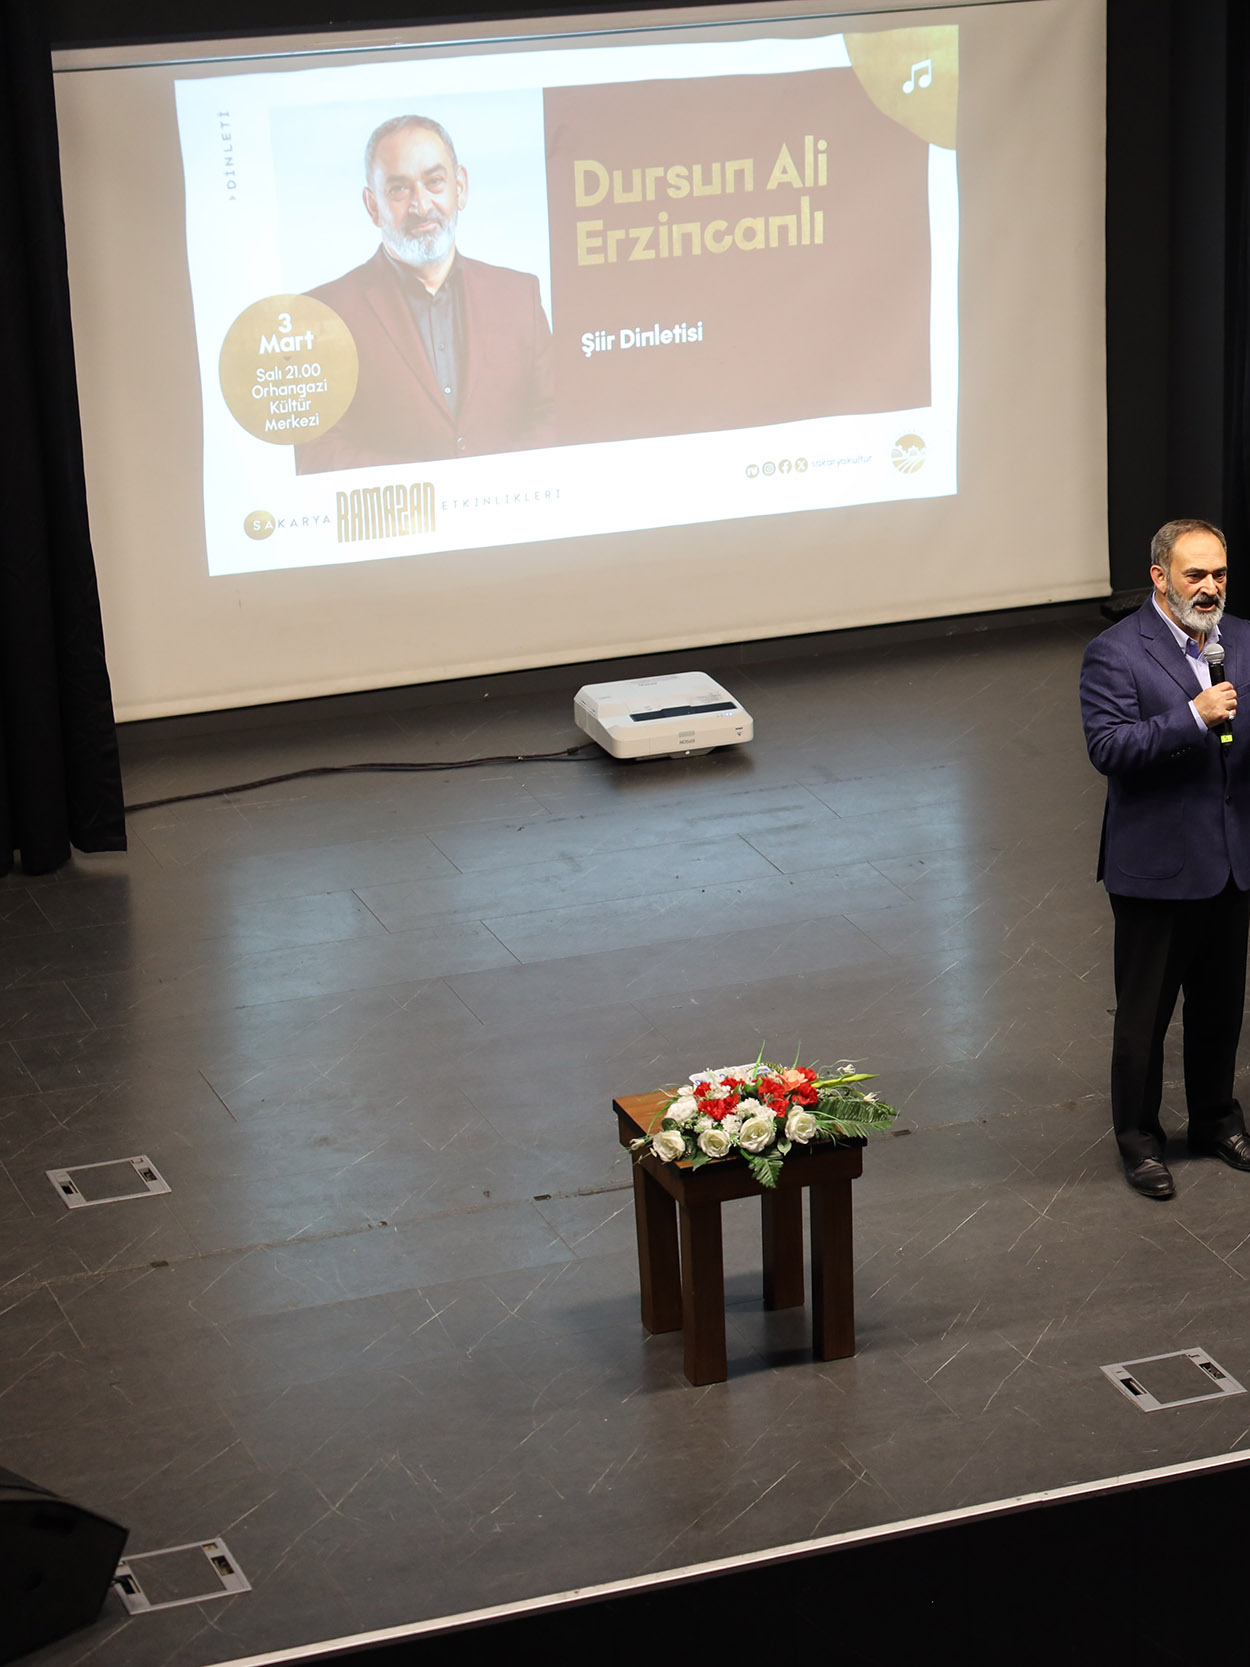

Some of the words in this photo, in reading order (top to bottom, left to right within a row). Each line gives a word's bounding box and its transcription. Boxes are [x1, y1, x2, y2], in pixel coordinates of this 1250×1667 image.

[574, 158, 754, 208] Dursun
[766, 135, 828, 190] Ali
[576, 195, 824, 266] Erzincanlı
[277, 312, 293, 334] 3
[258, 330, 315, 355] Mart
[581, 331, 616, 358] Şiir
[620, 321, 704, 349] Dinletisi
[256, 366, 283, 382] Salı
[285, 363, 321, 380] 21.00
[251, 379, 328, 399] Orhangazi
[269, 398, 312, 414] Kültür
[264, 413, 320, 432] Merkezi
[252, 513, 331, 530] SAKARYA
